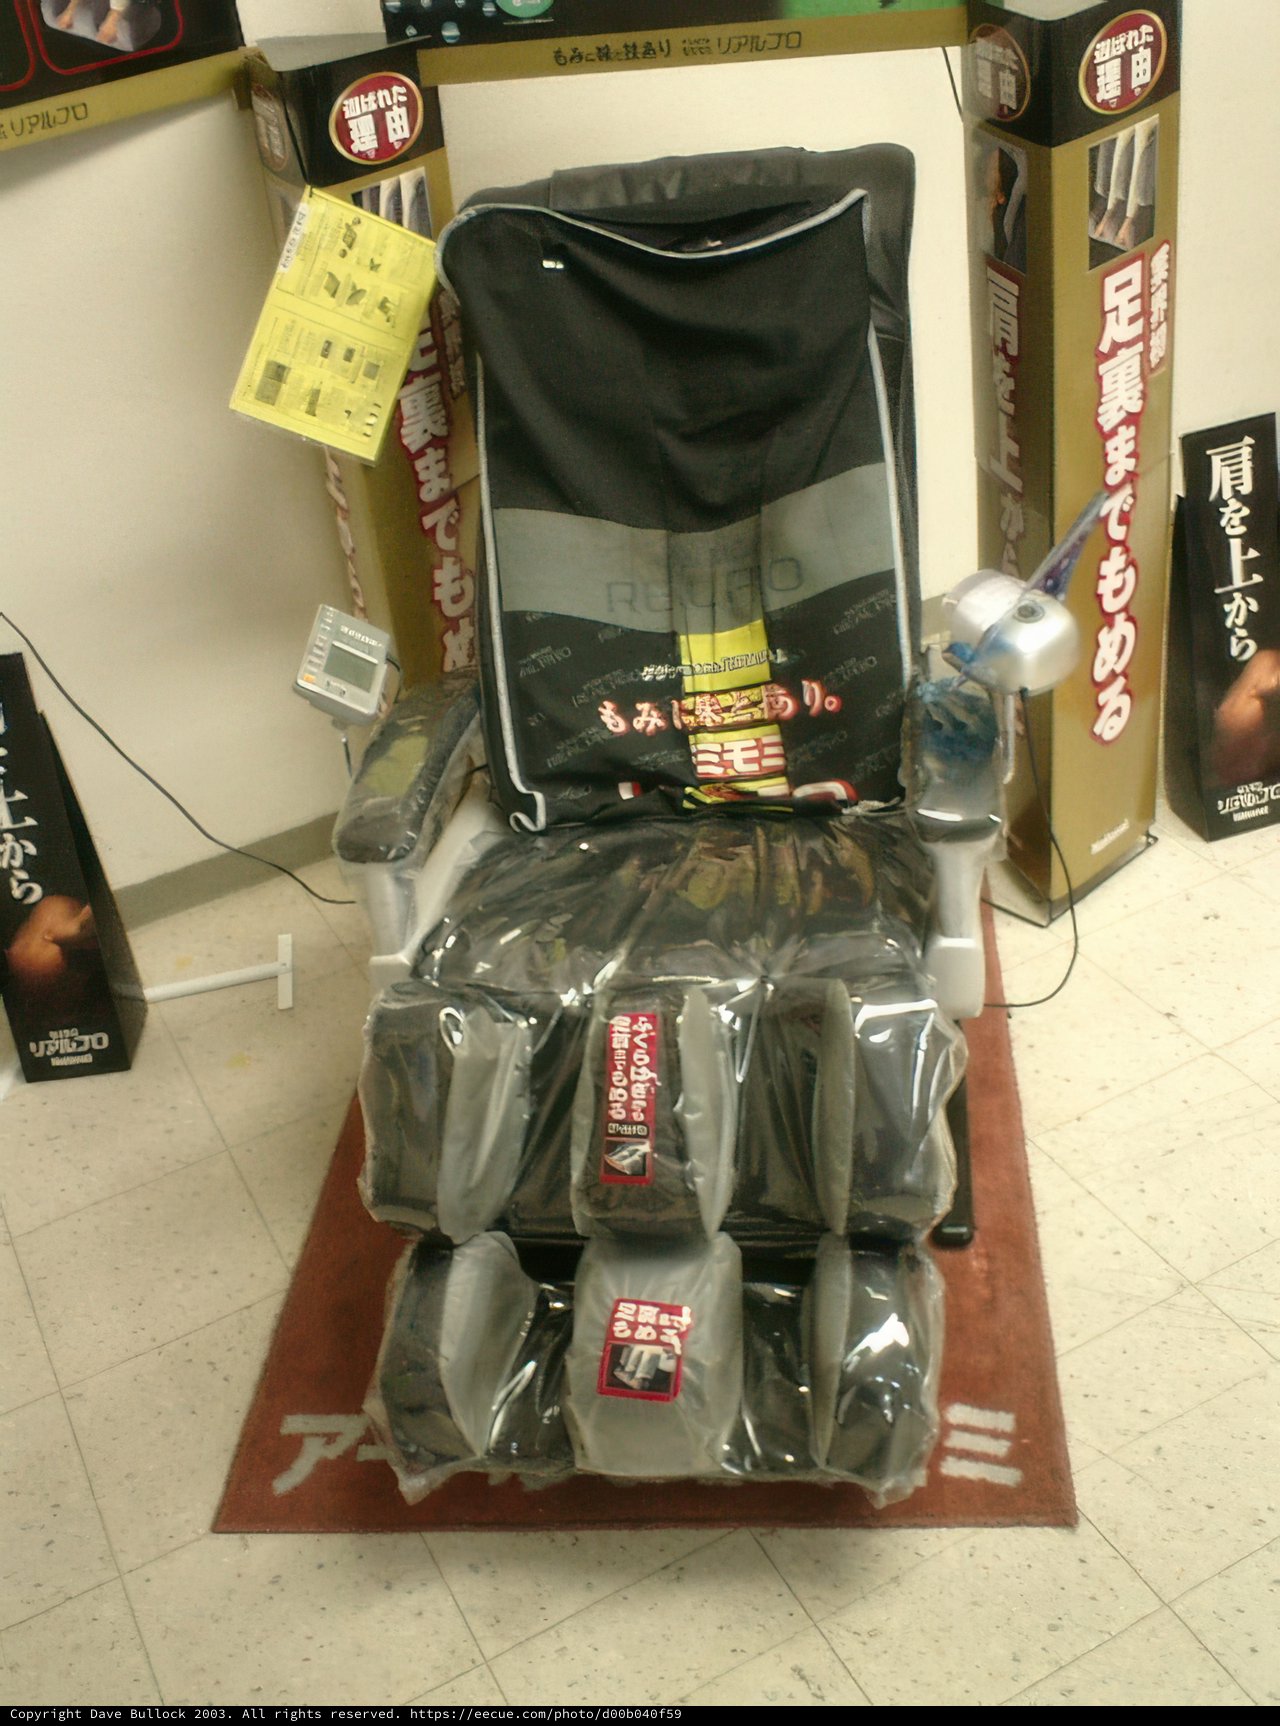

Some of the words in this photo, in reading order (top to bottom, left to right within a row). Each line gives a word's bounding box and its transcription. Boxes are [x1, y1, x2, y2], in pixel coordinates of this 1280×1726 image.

[1093, 259, 1144, 742] 足裏までもめる
[1206, 435, 1264, 661] 肩を上から
